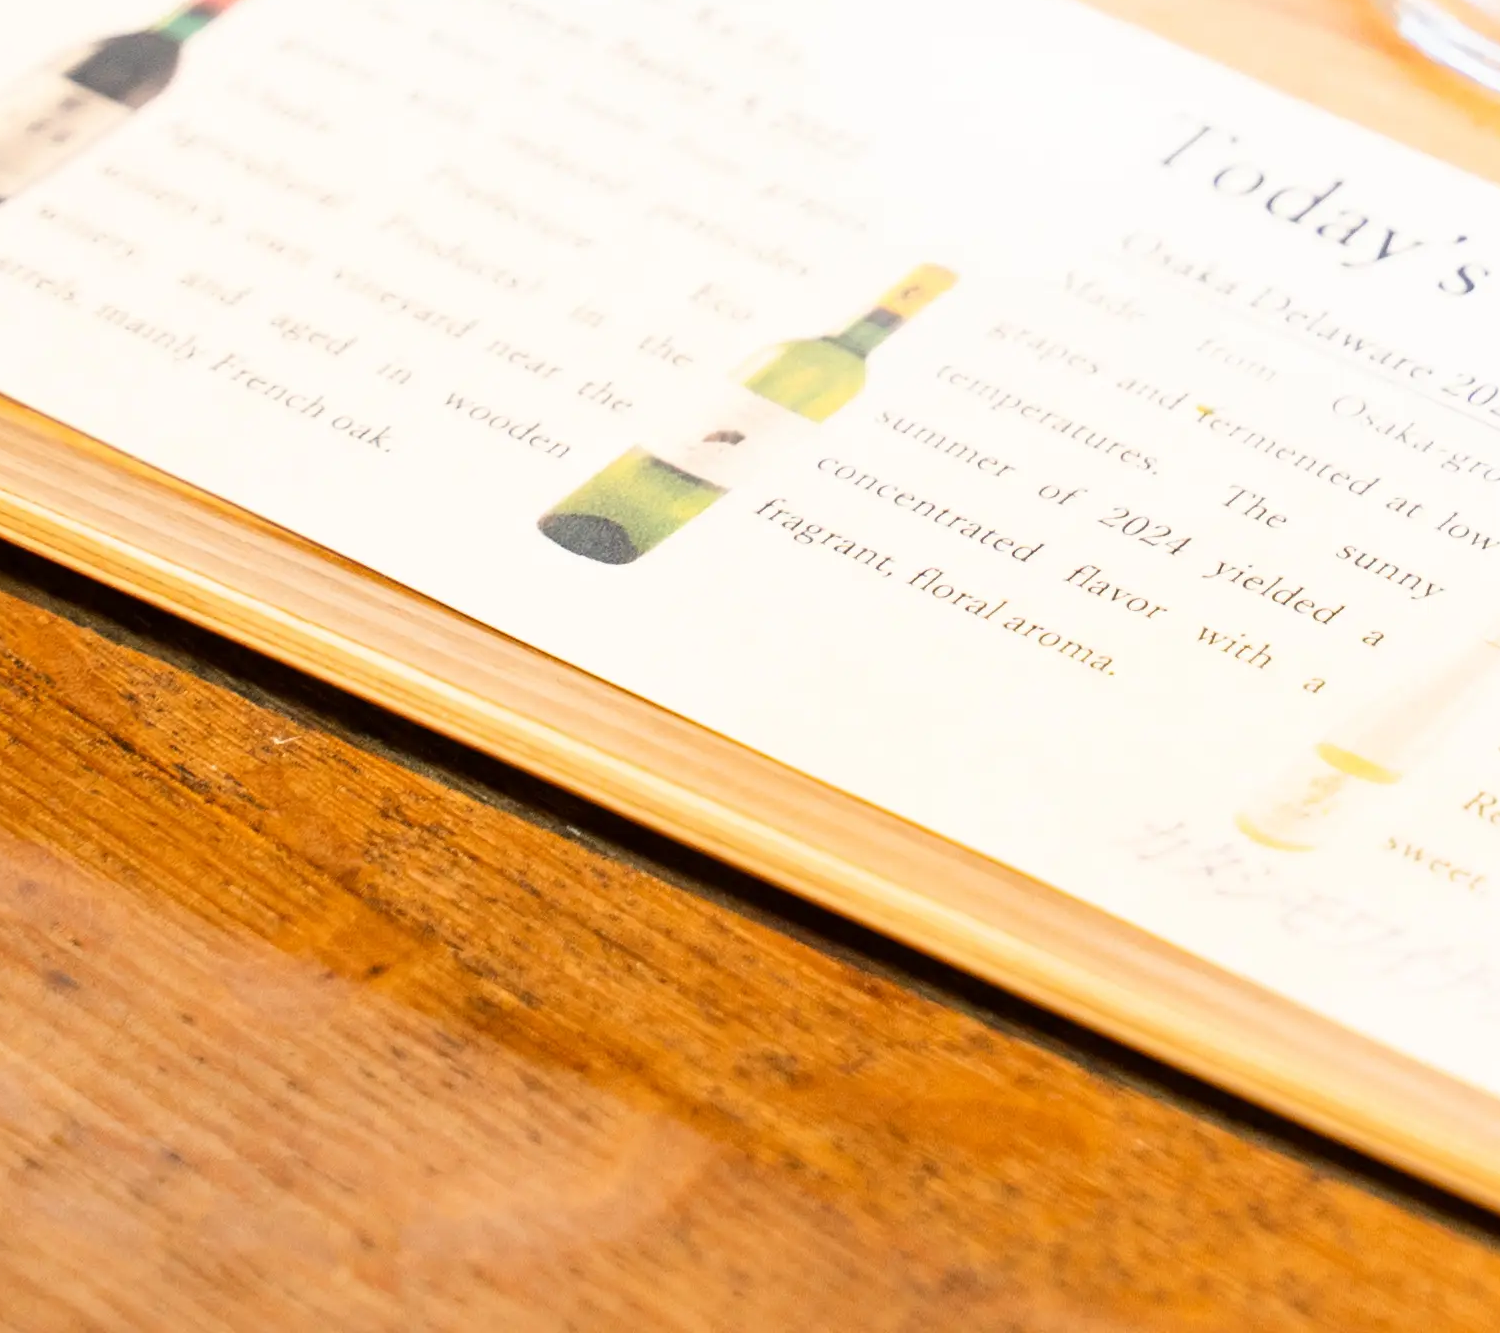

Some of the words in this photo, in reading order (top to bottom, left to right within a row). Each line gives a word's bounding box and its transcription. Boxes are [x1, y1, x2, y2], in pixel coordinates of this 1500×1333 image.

[1159, 109, 1491, 299] Today's
[95, 301, 207, 366] mainly
[210, 347, 327, 423] French
[331, 410, 398, 456] oak.
[179, 266, 254, 310] and
[269, 309, 356, 362] aged
[377, 355, 414, 389] in
[443, 387, 574, 462] wooden
[332, 264, 477, 343] vineyard
[486, 336, 563, 381] near
[577, 375, 635, 416] the
[568, 299, 606, 331] in
[638, 332, 696, 372] the
[1058, 266, 1149, 326] Made
[1196, 334, 1278, 386] from
[1119, 228, 1239, 303] Osaka
[1249, 287, 1436, 382] Delaware
[934, 361, 1160, 480] temperatures.
[1222, 482, 1290, 533] The
[1334, 539, 1446, 605] sunny
[985, 316, 1102, 392] grapes
[1116, 370, 1190, 416] and
[1192, 400, 1381, 500] fermented
[1385, 486, 1425, 517] at
[755, 498, 896, 582] fragrant,
[905, 567, 1001, 627] floral
[1003, 607, 1120, 679] aroma.
[815, 455, 1044, 566] concentrated
[1065, 563, 1169, 625] flavor
[1196, 620, 1276, 674] with
[1302, 672, 1328, 697] a
[876, 408, 1017, 485] summer
[1037, 477, 1083, 511] of
[1097, 504, 1195, 560] 2024
[1202, 555, 1347, 627] yielded
[1362, 625, 1388, 650] a
[1382, 836, 1490, 900] sweet.
